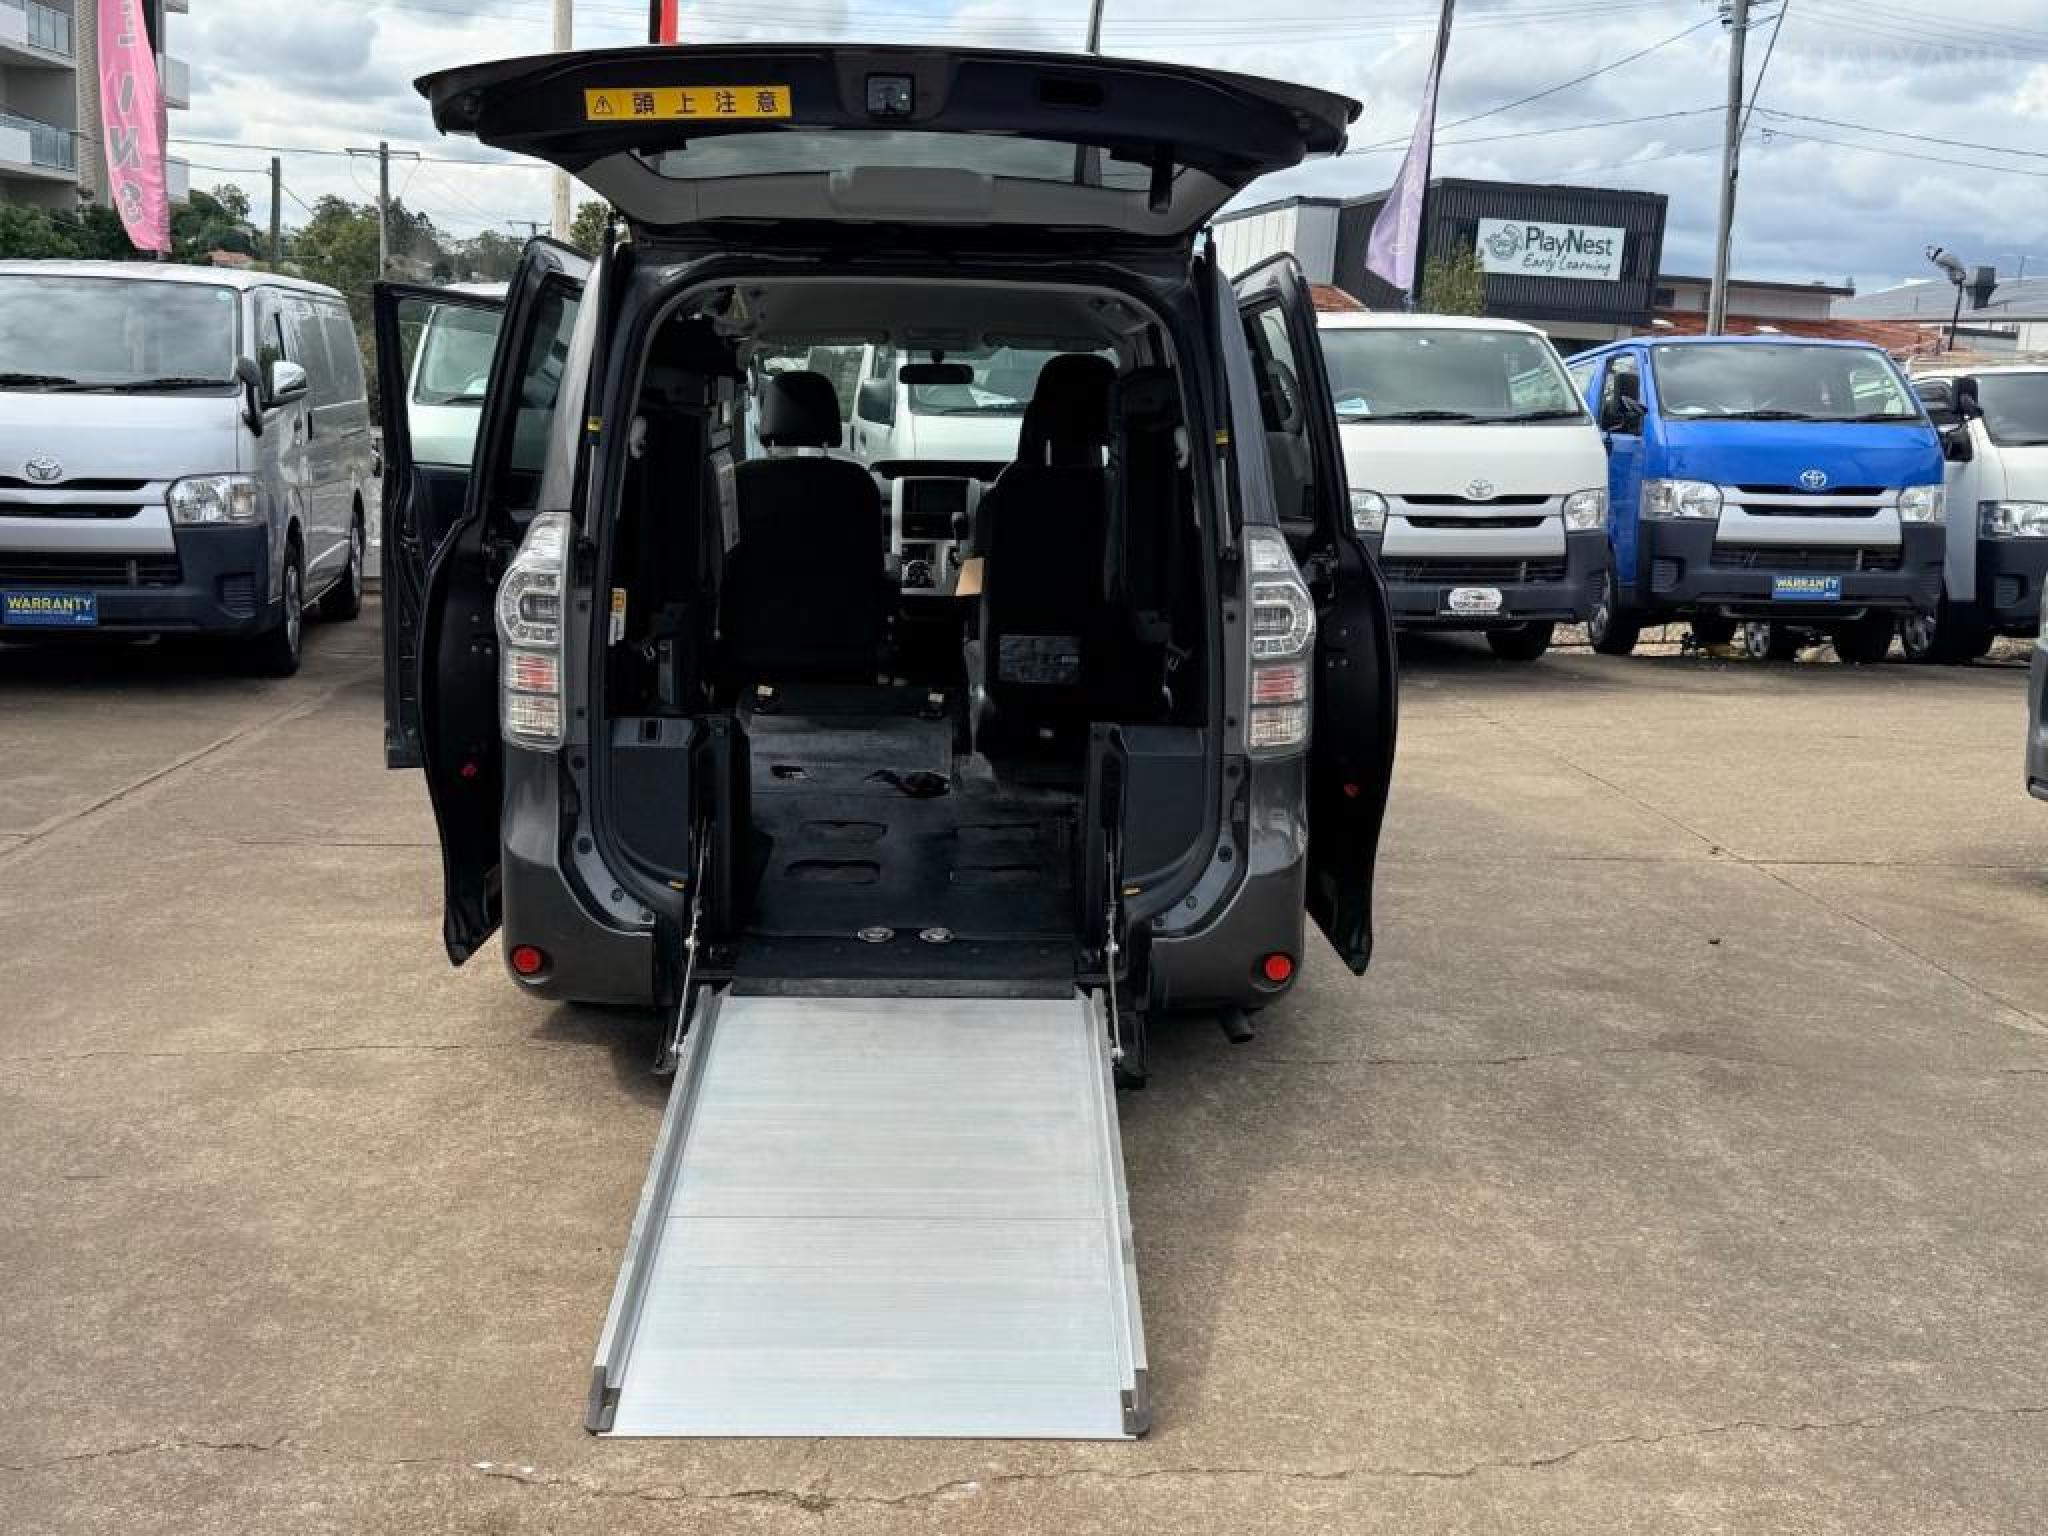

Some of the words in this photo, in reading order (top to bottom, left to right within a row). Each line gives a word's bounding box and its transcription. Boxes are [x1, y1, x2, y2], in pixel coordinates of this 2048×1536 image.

[632, 91, 779, 114] 頭上注意
[1526, 226, 1613, 257] PlayNest
[1522, 253, 1555, 272] Early
[1559, 255, 1610, 276] Learning
[7, 597, 91, 611] WARRANTY
